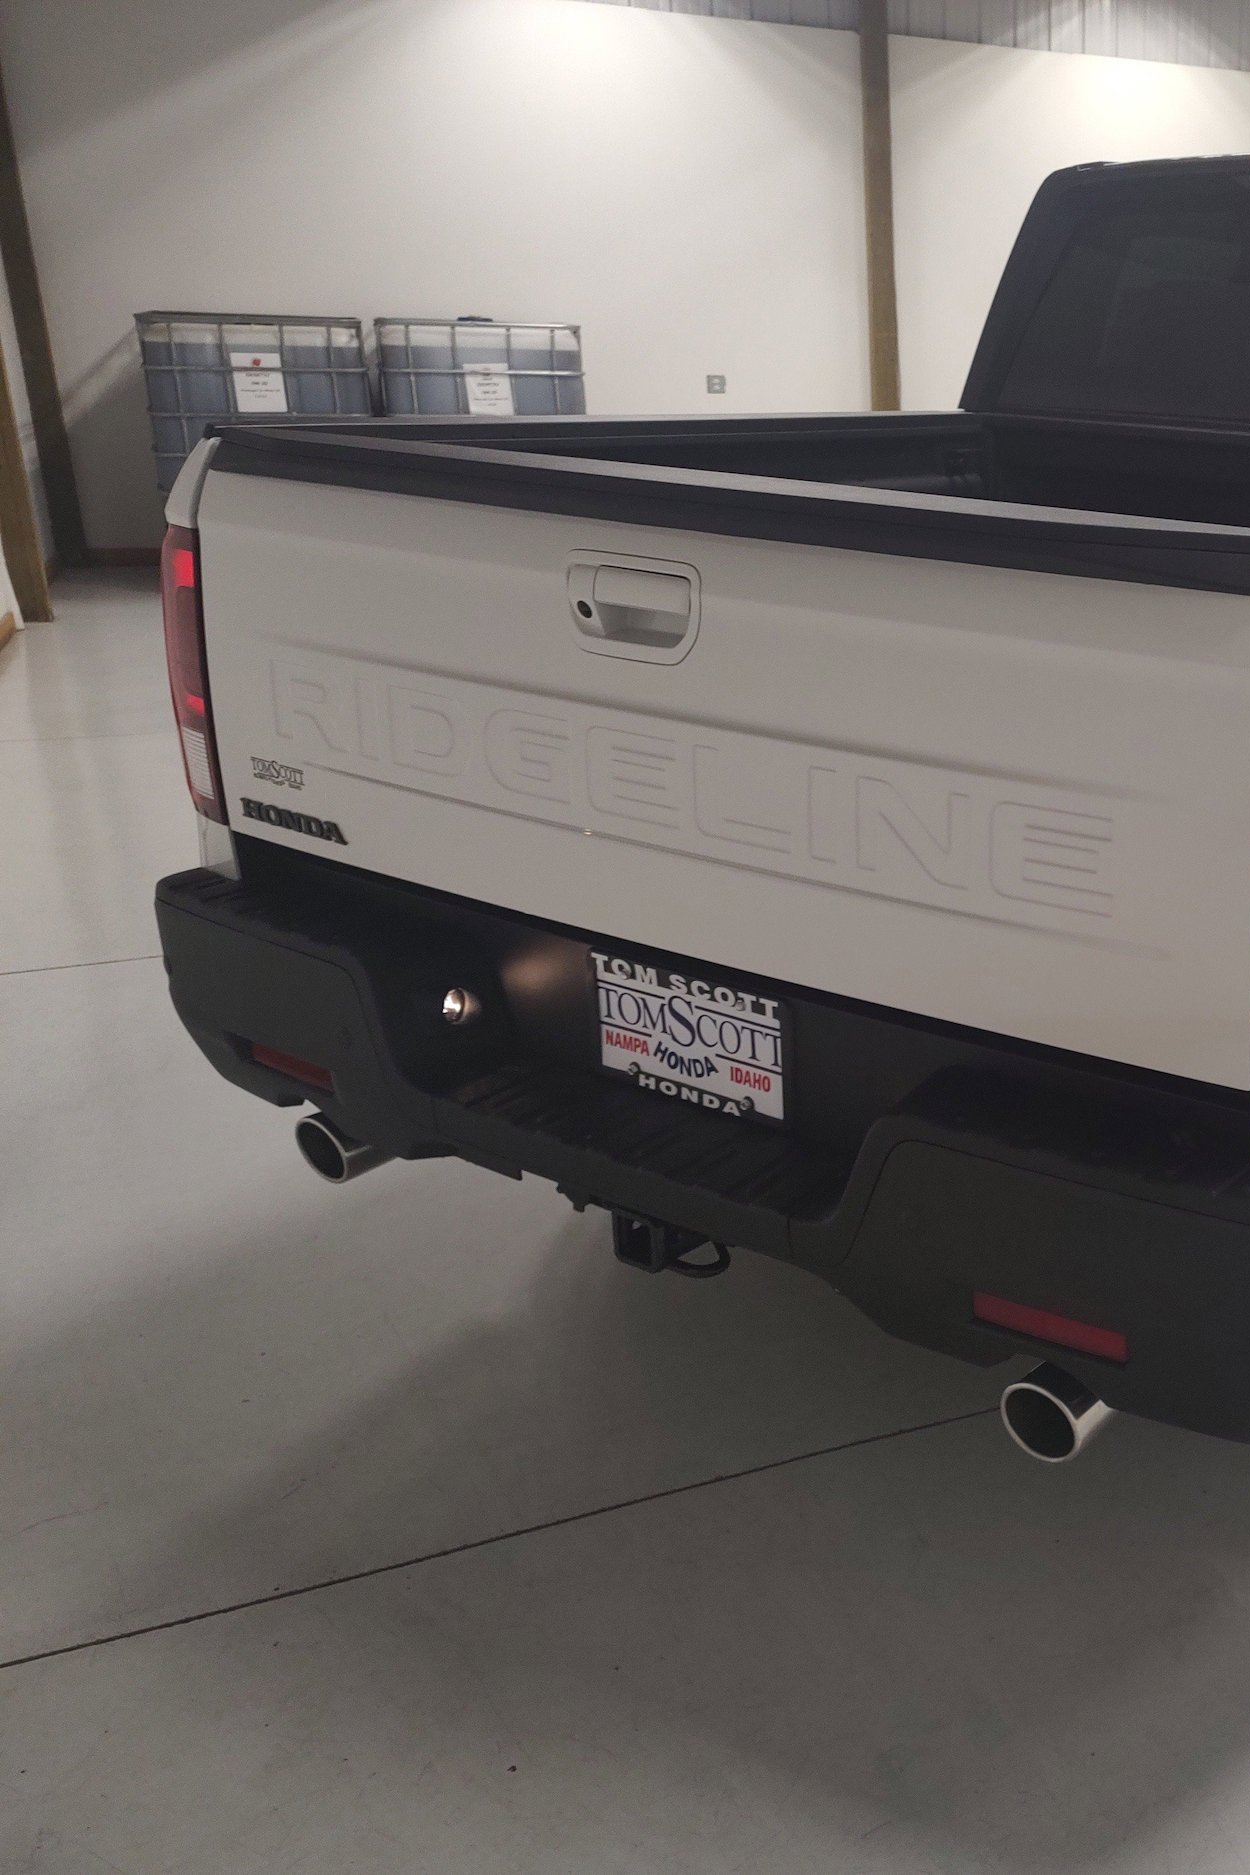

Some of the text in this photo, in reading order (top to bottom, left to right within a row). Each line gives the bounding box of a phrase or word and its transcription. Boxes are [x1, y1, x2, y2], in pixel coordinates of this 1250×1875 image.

[269, 657, 1116, 919] RIDGELINE
[240, 797, 349, 845] HONDA
[590, 952, 779, 1019] TOM SCOTT
[605, 1030, 650, 1056] NAMPA
[653, 1041, 719, 1078] HONDA
[638, 1074, 741, 1116] HONDA
[730, 1066, 771, 1092] IDAHO
